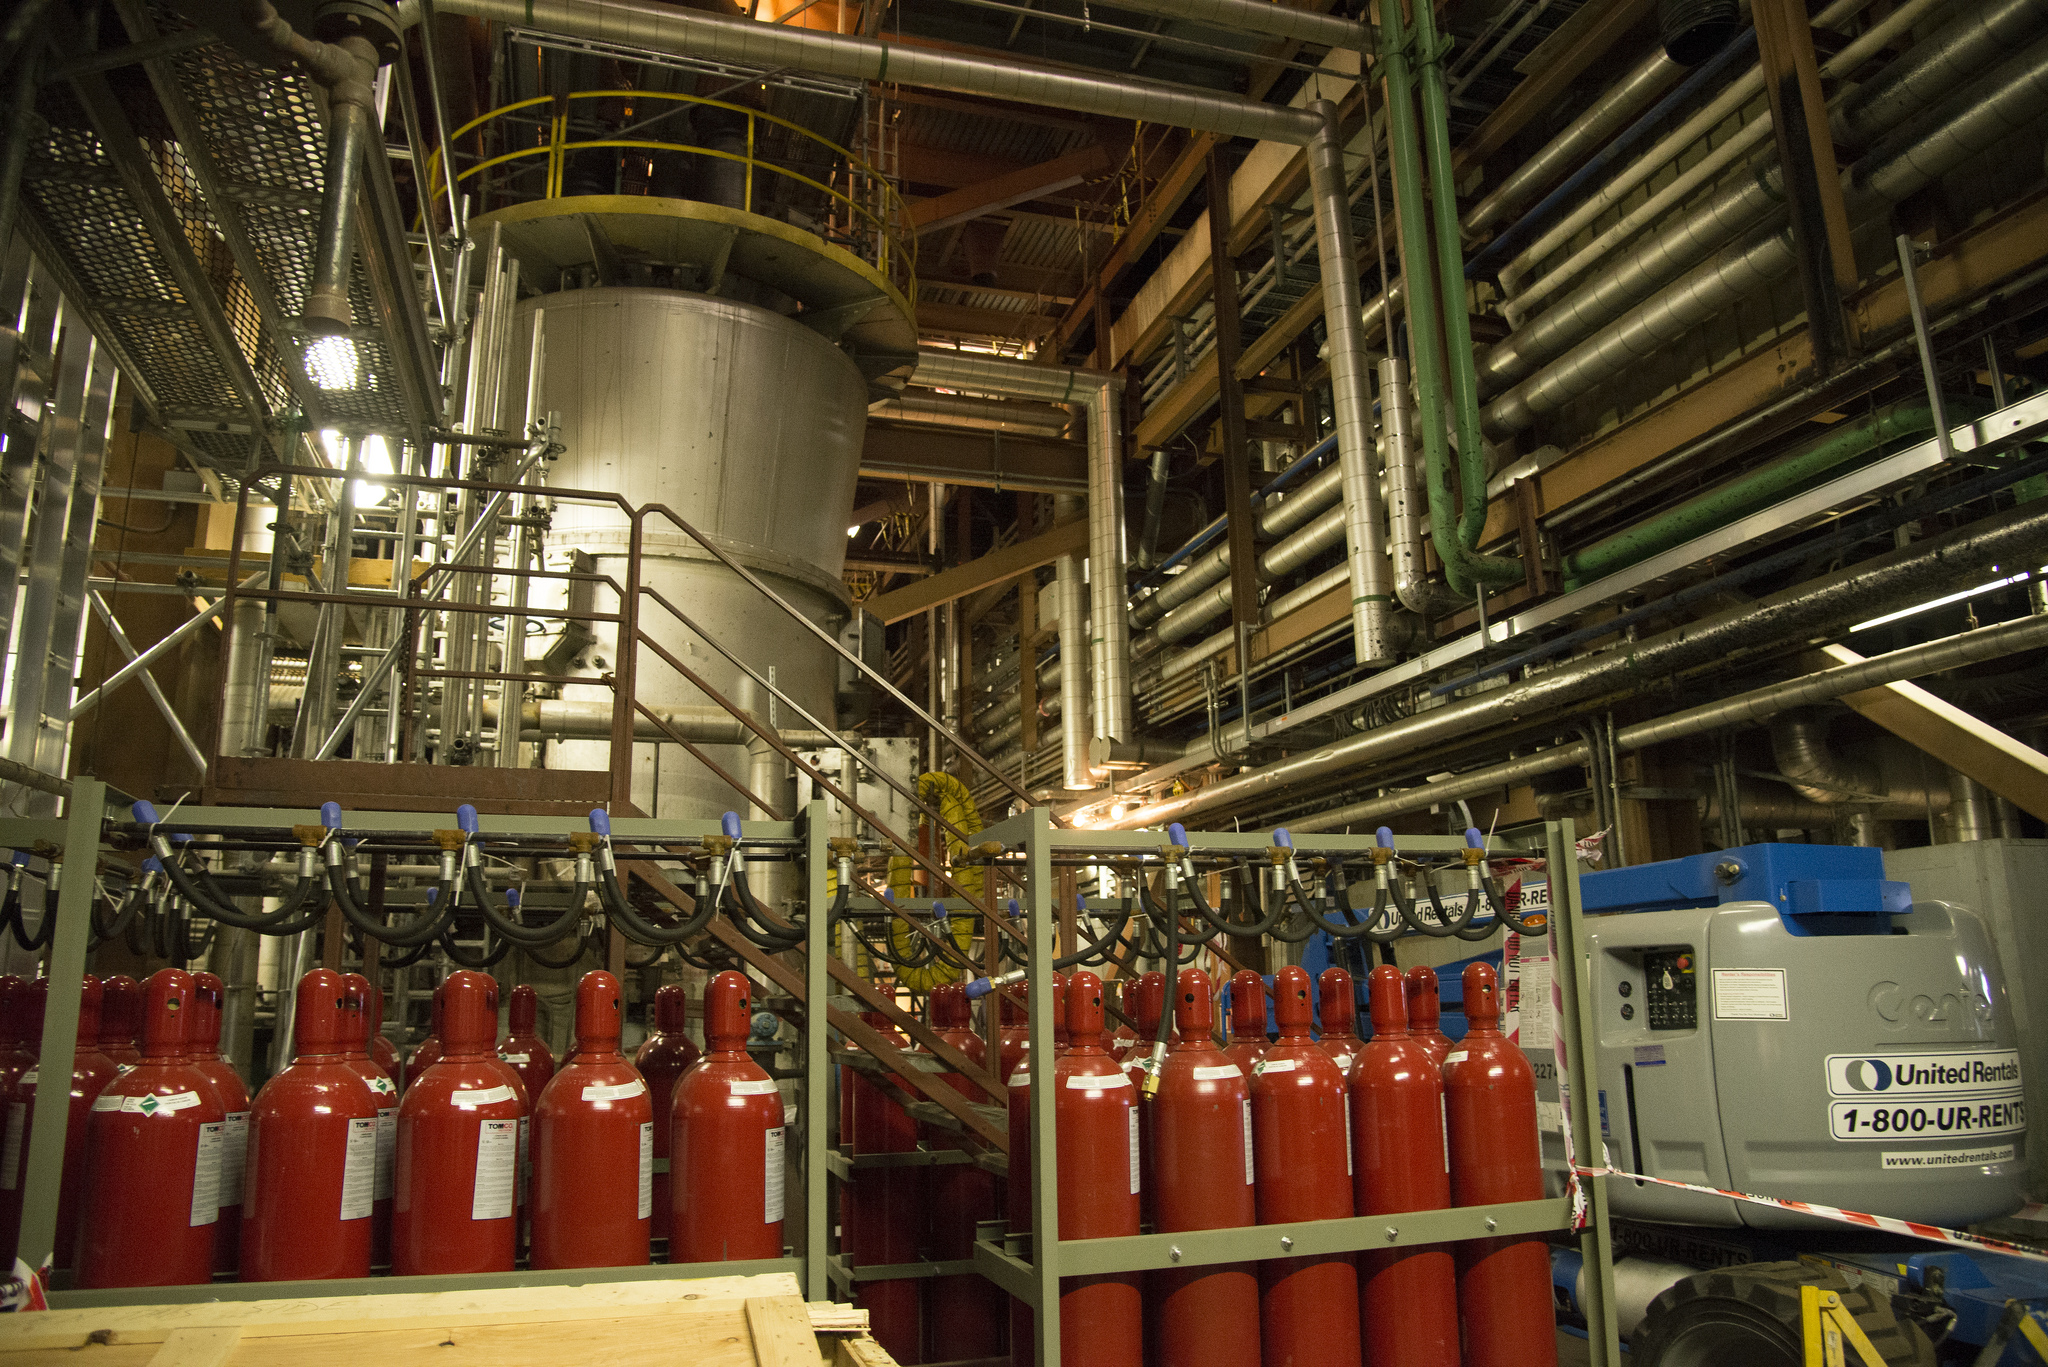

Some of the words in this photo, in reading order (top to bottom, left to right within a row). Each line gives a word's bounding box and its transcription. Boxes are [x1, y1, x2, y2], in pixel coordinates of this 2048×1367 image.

[1424, 901, 1463, 921] Retals
[1866, 979, 1996, 1031] Genie
[1895, 1061, 1970, 1086] United
[1973, 1058, 2019, 1083] Rentals
[1843, 1100, 2025, 1132] 1-800-UR-RENTS
[1886, 1149, 2013, 1166] www.unitedrentals.com
